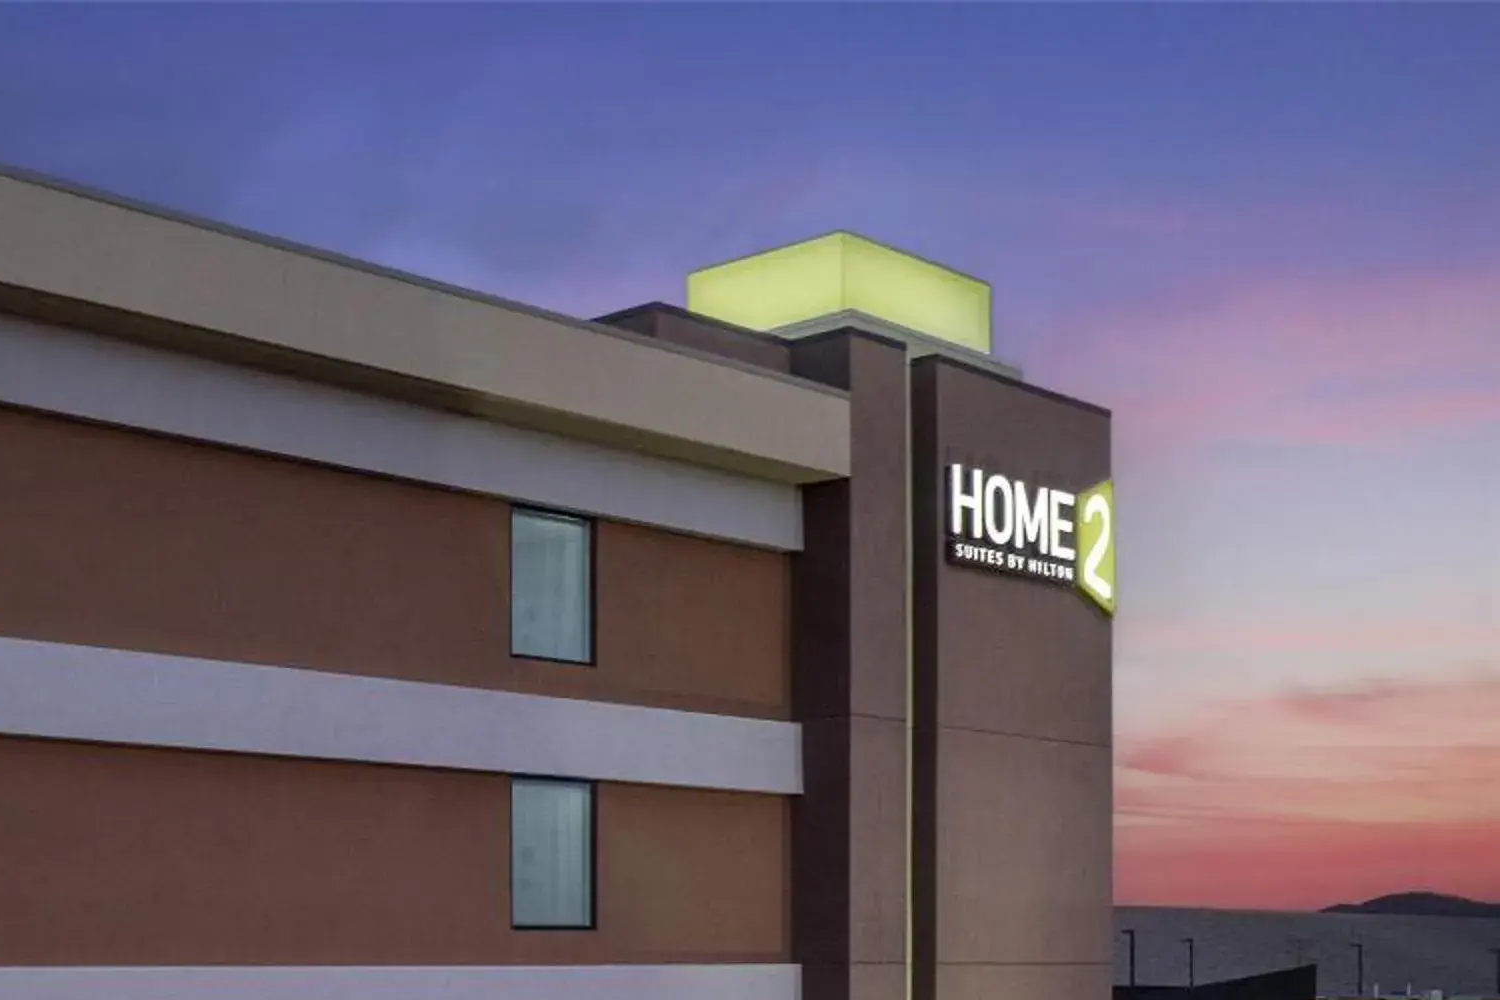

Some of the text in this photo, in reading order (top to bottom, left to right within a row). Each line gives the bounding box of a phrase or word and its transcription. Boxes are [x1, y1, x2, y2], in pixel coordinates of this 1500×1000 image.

[952, 463, 1112, 599] HOME 2
[955, 543, 1073, 580] SUITES BY HILTON
